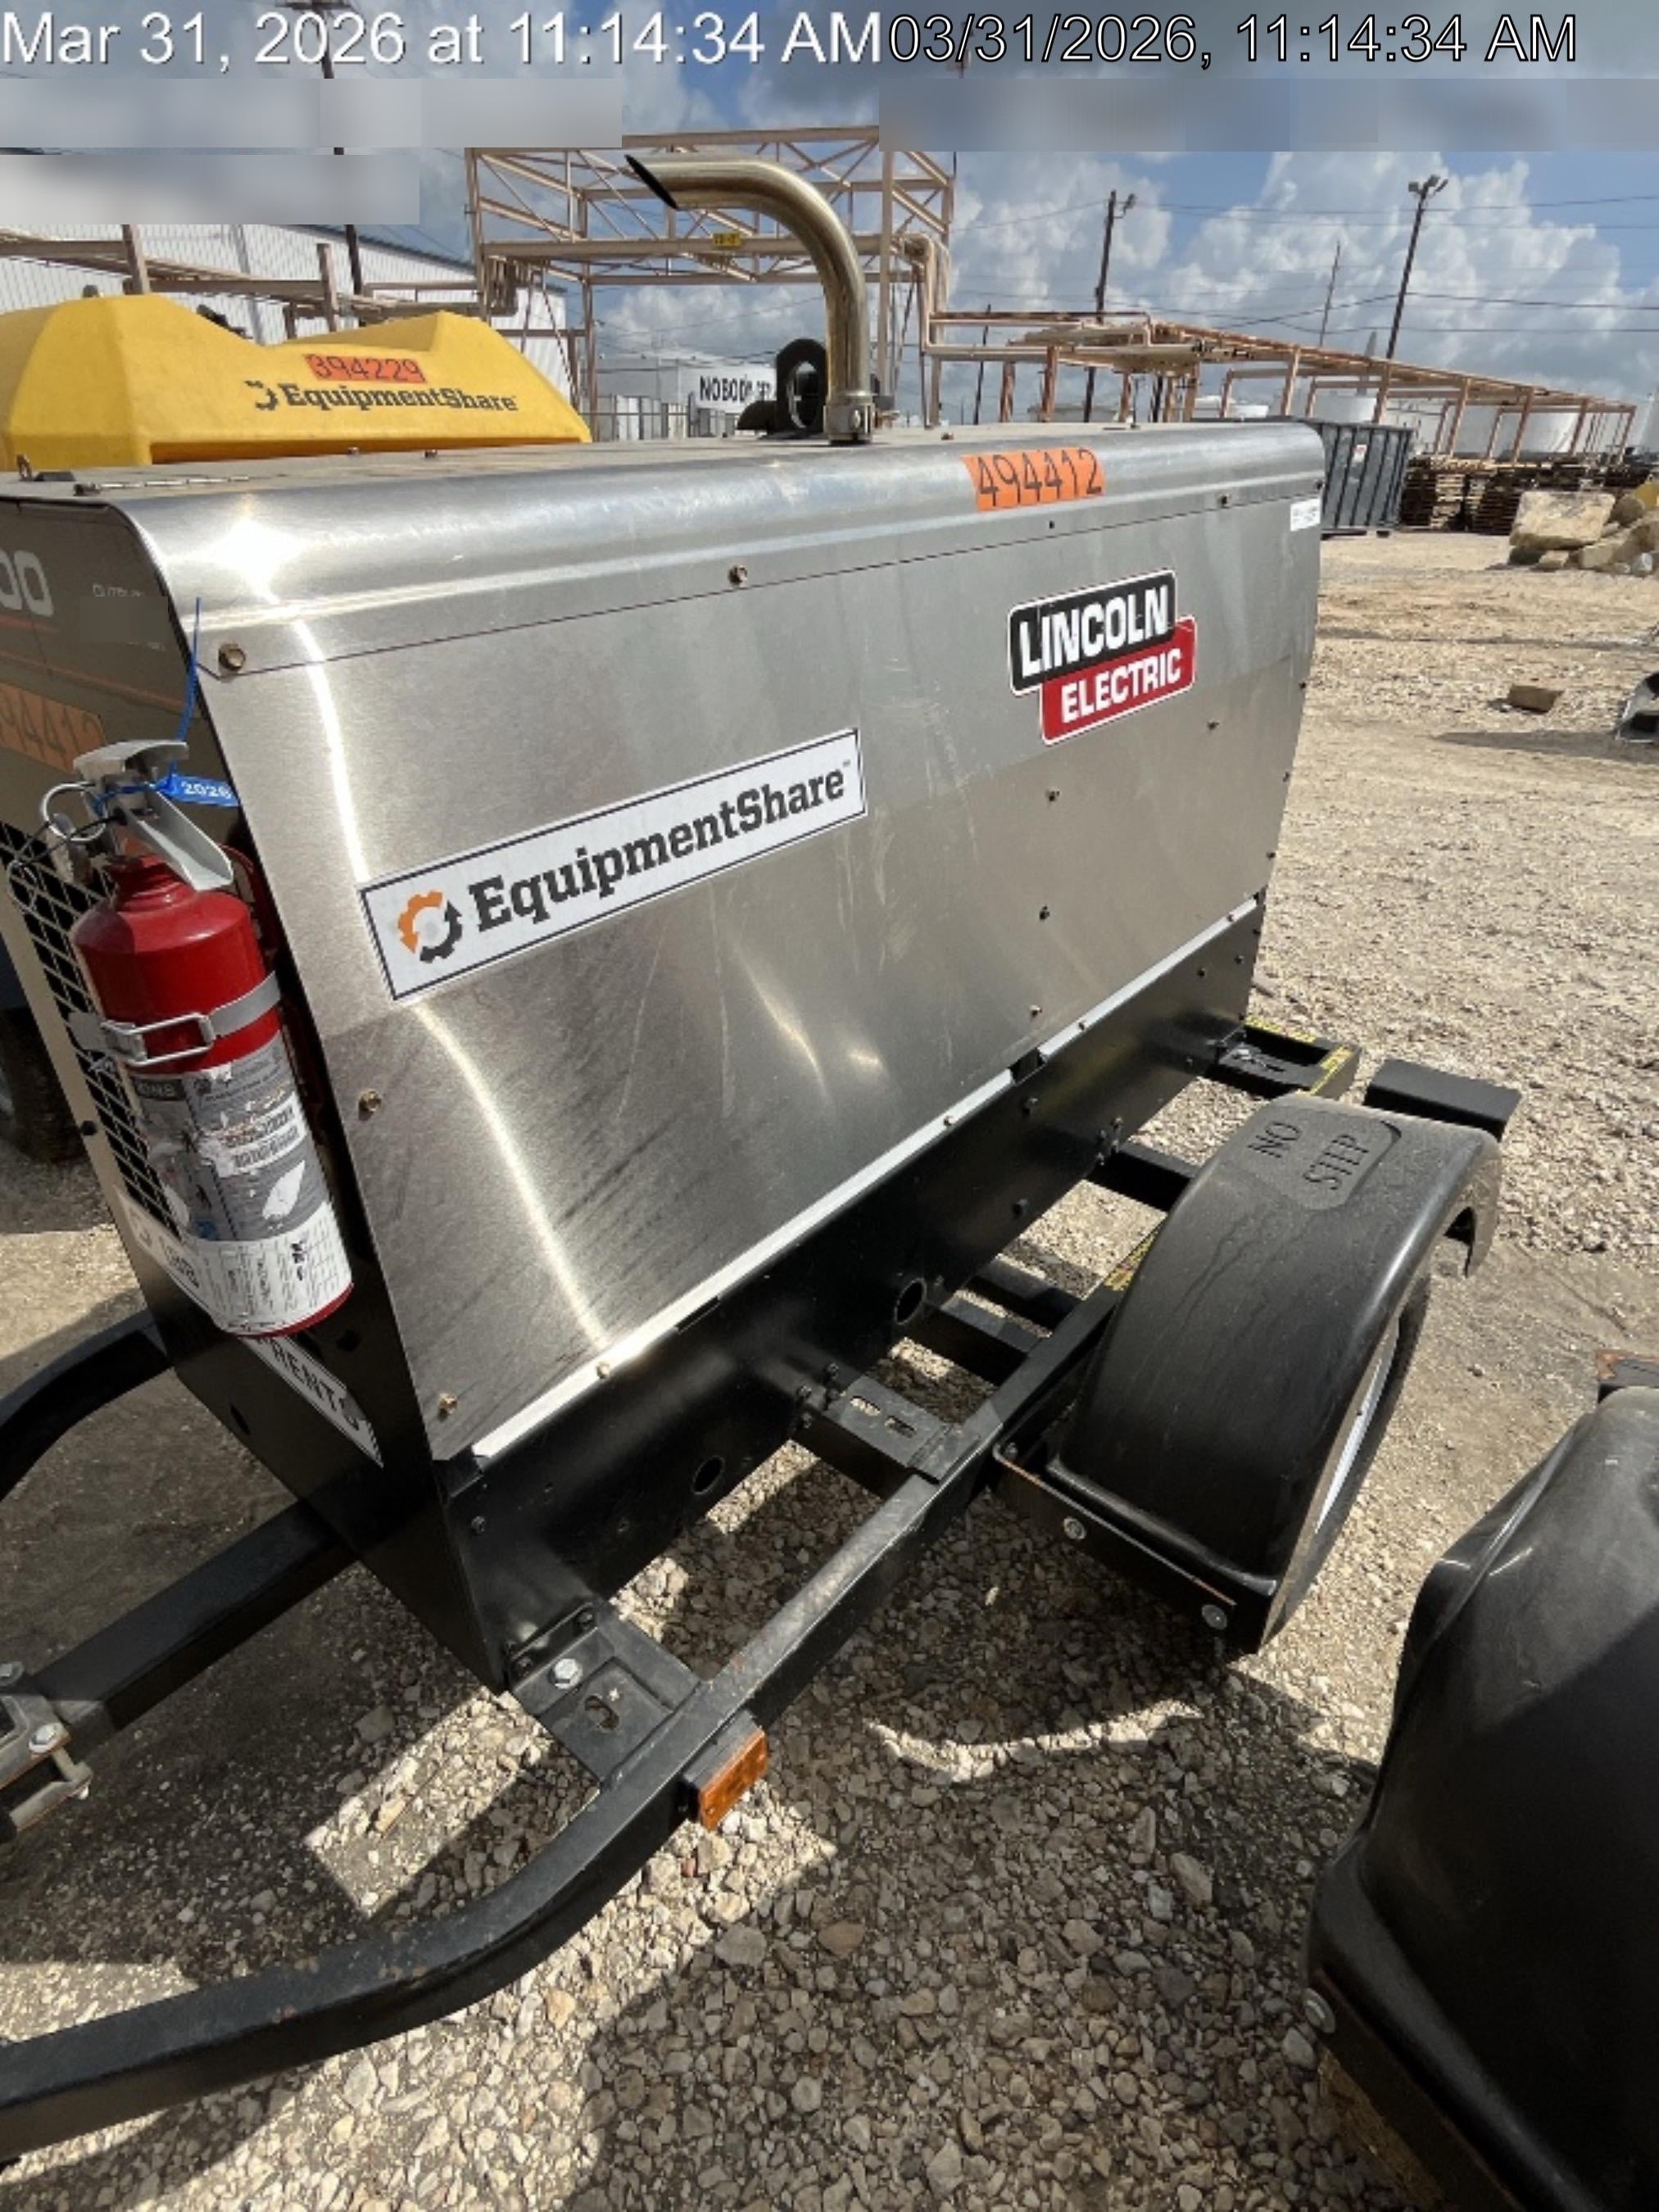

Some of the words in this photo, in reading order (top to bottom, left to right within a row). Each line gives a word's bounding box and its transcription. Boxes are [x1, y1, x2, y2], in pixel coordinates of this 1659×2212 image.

[278, 383, 519, 410] EquipmentShare
[306, 353, 426, 383] 394229
[977, 448, 1102, 506] 494412
[1020, 585, 1170, 678] LINCOLN
[1062, 649, 1182, 724] ELECTRIC
[469, 768, 845, 931] EquipmentShare
[1247, 1121, 1303, 1158] NO
[1303, 1134, 1370, 1190] STEP
